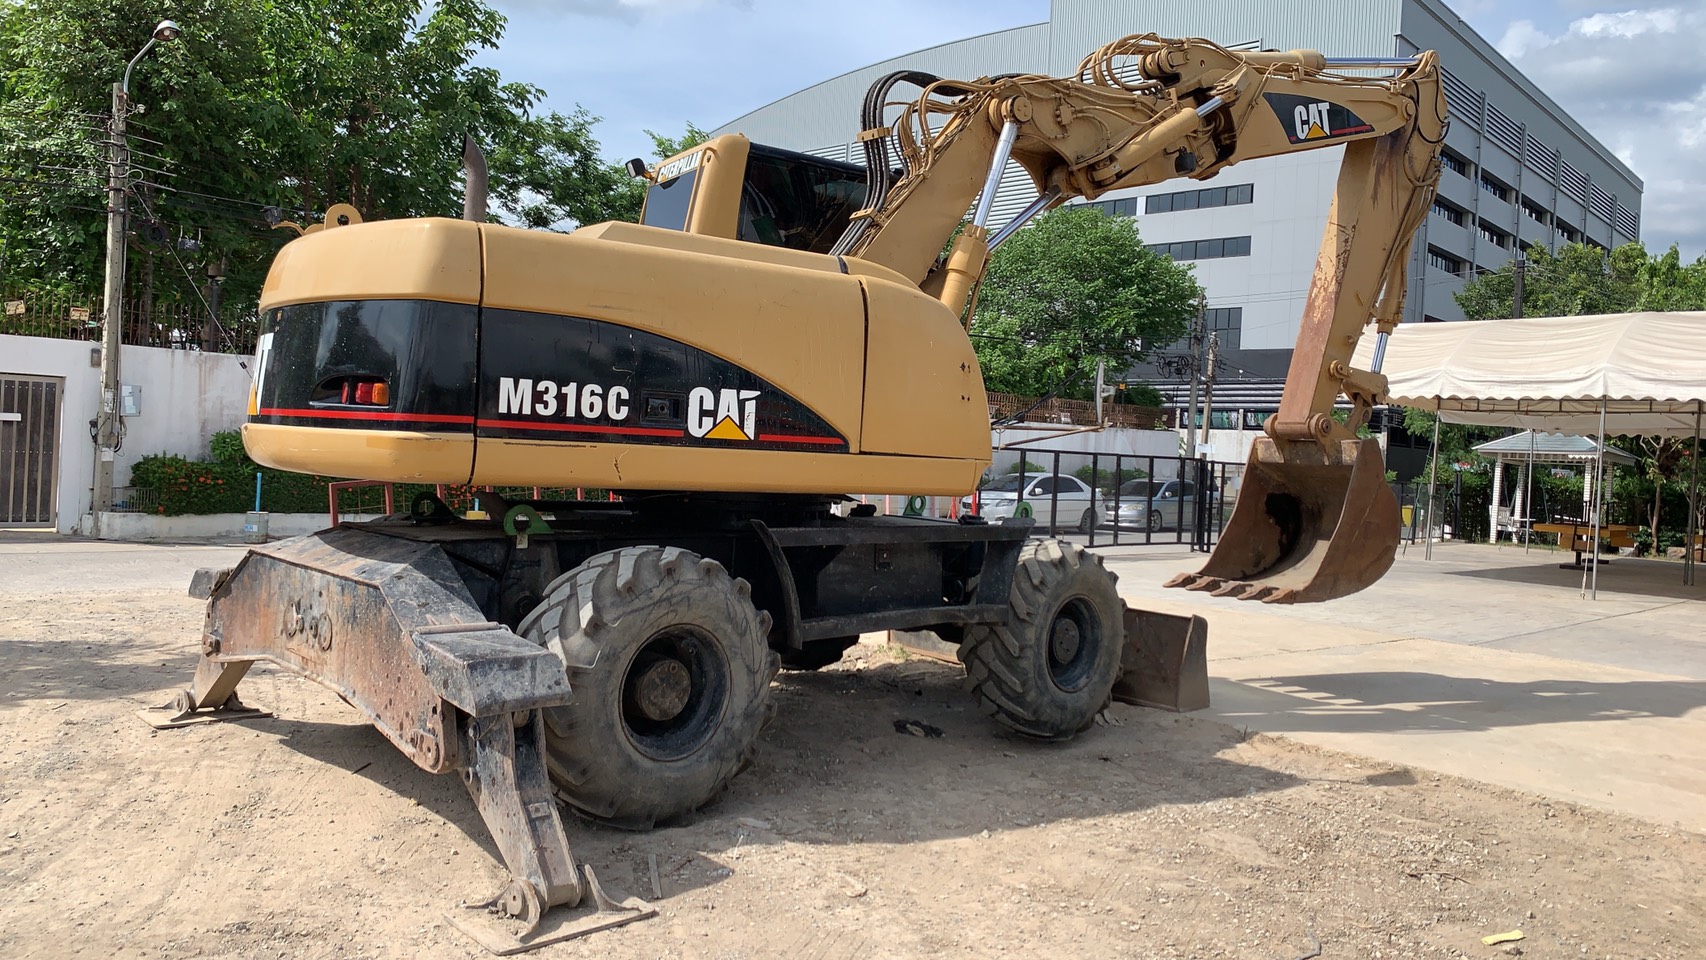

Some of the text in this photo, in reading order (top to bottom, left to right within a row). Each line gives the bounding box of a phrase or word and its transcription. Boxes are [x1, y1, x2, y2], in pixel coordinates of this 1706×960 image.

[1294, 102, 1330, 140] CAT
[499, 378, 630, 420] M316C
[687, 386, 761, 440] CAT
